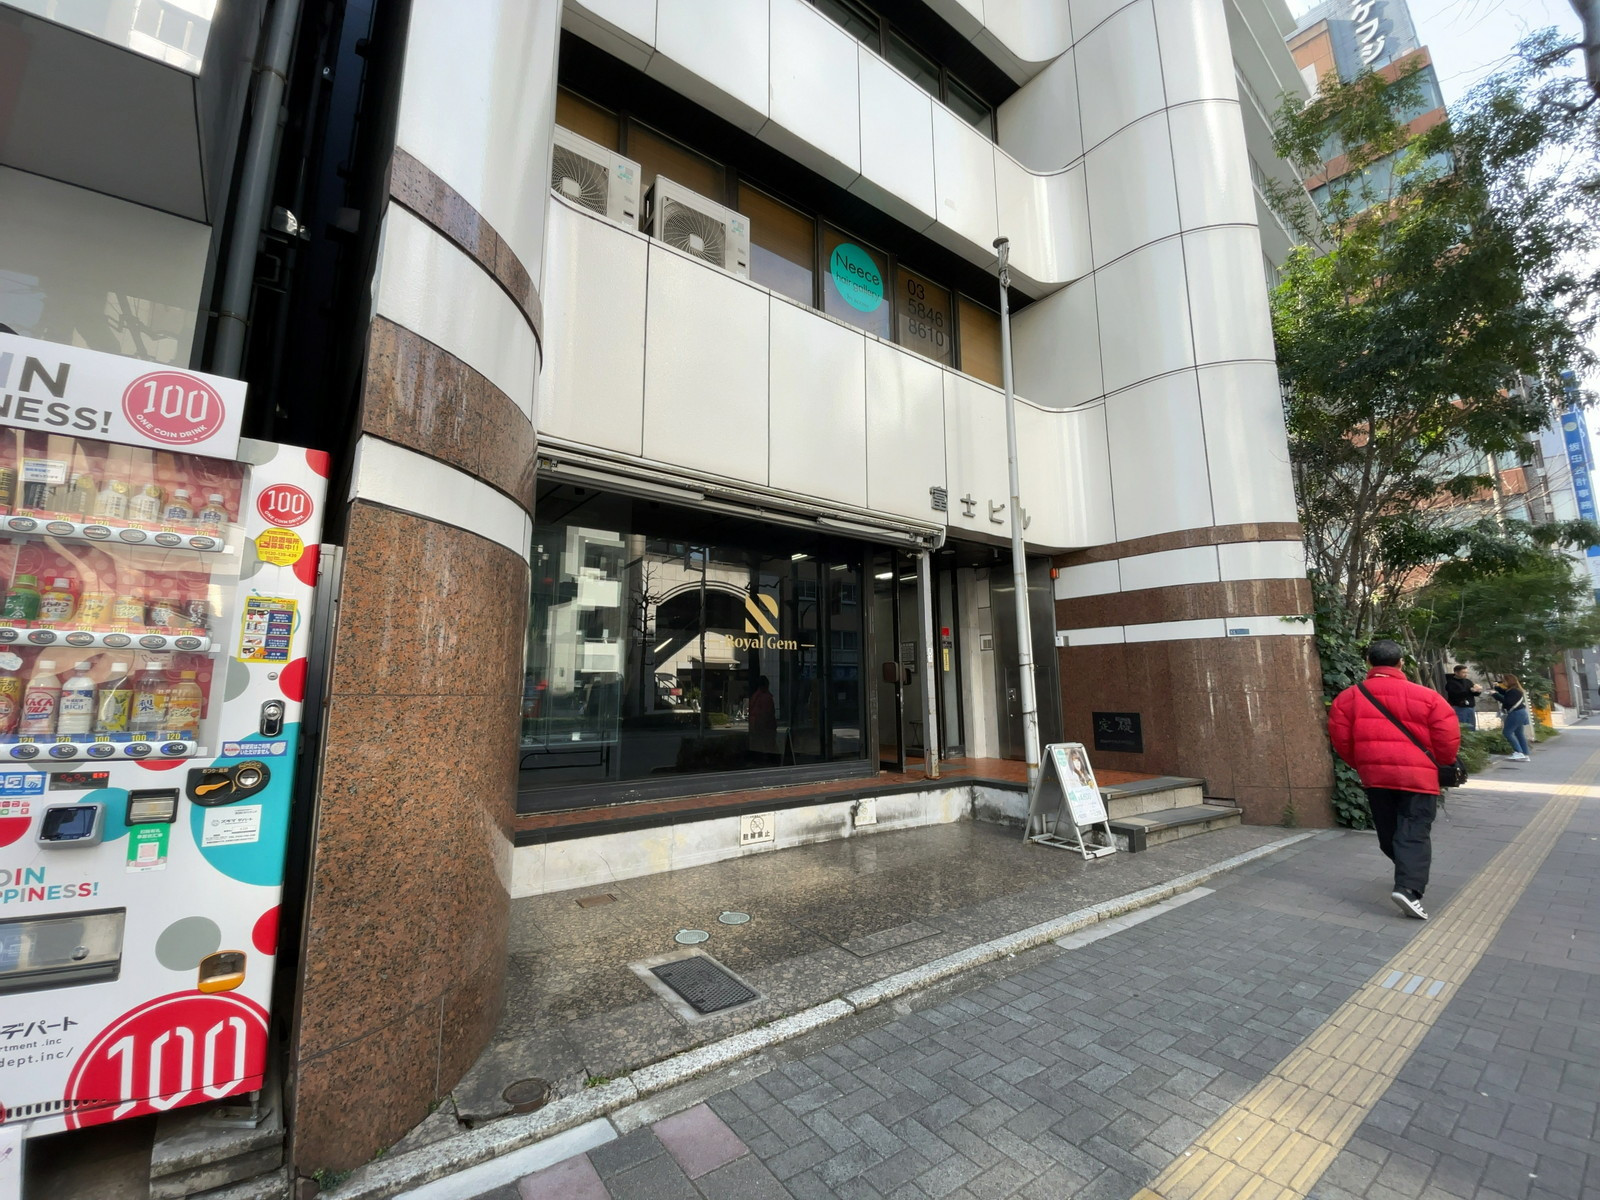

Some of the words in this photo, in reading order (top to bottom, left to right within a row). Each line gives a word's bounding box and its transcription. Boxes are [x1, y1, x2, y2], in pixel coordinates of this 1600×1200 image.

[1350, 0, 1385, 65] ケフジ
[836, 251, 880, 286] Neece
[836, 271, 852, 285] hair
[852, 281, 881, 302] gallery
[907, 279, 925, 300] 03
[908, 300, 944, 328] 5846
[908, 318, 944, 347] 8610
[143, 380, 209, 423] 100
[136, 414, 154, 430] ONE
[154, 427, 177, 438] COIN
[180, 424, 208, 438] DRINK
[268, 490, 304, 514] 100
[725, 634, 764, 651] Royal
[767, 636, 798, 650] Gem
[0, 1016, 78, 1040] デパート
[107, 1016, 247, 1121] 100
